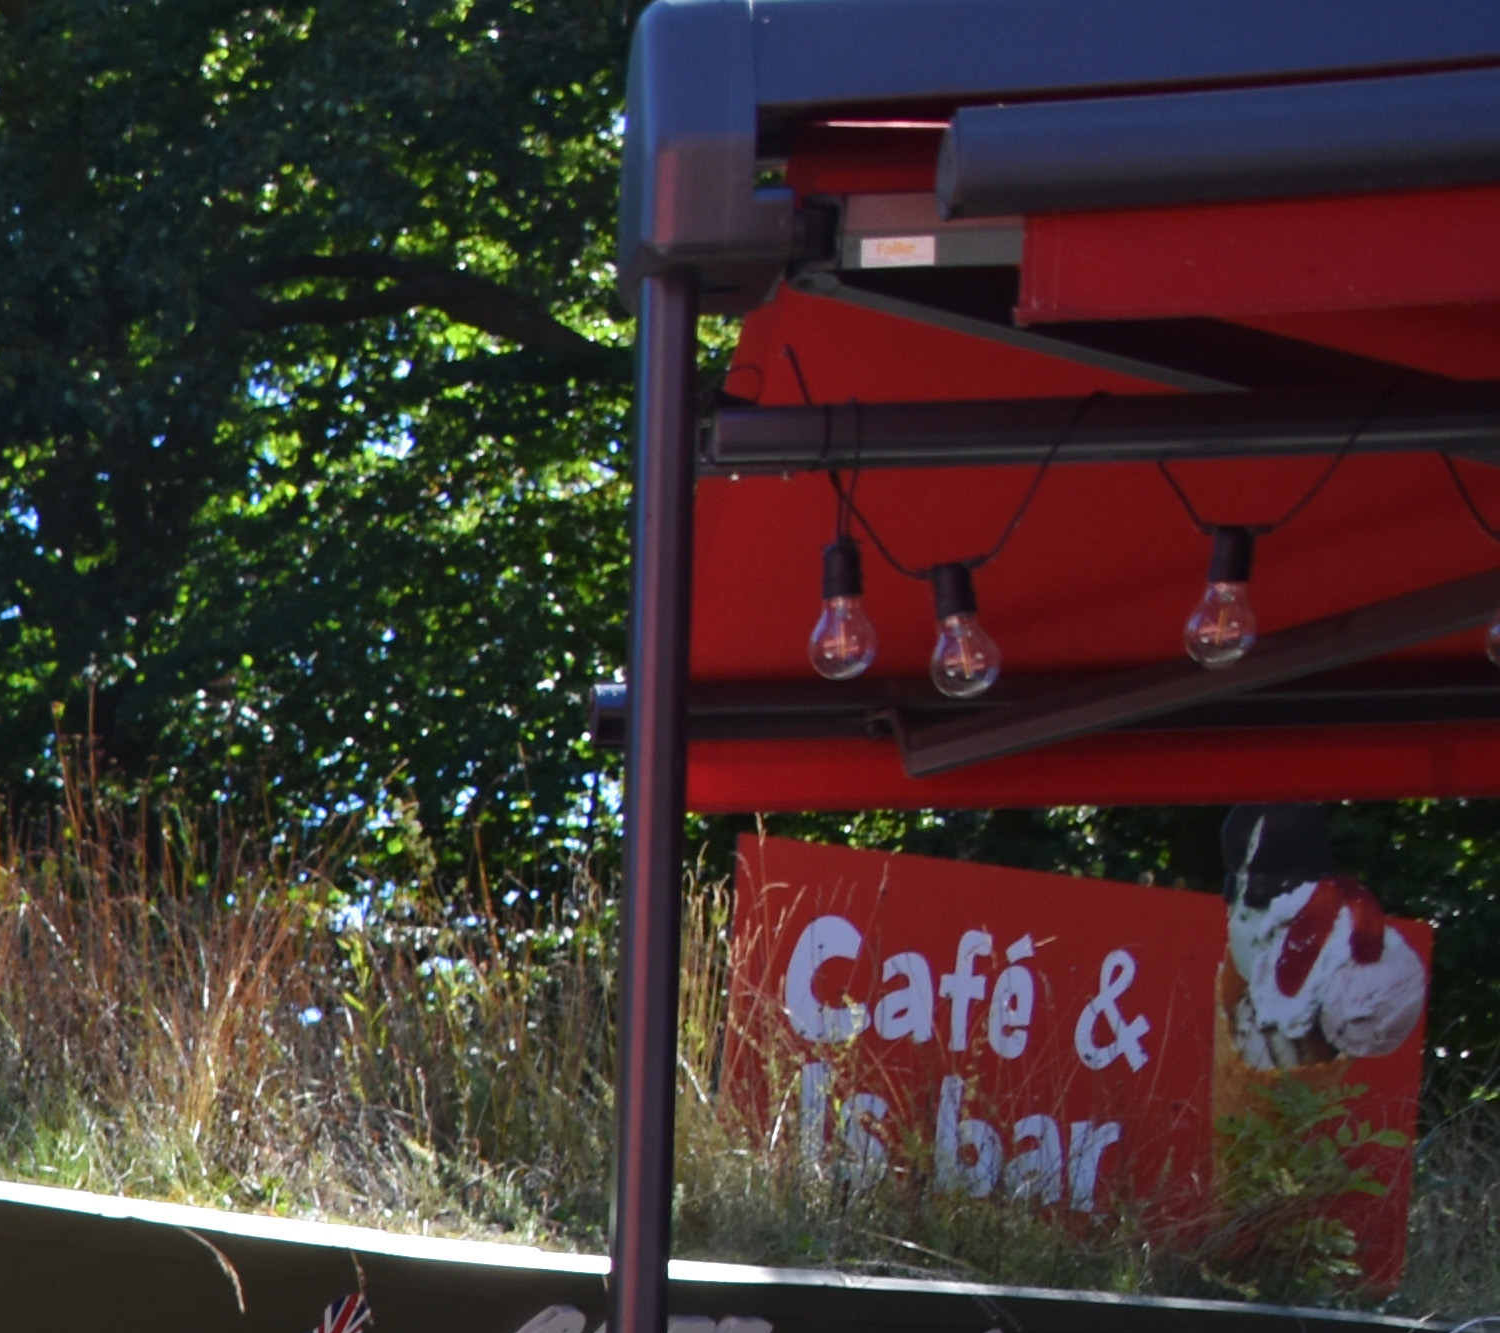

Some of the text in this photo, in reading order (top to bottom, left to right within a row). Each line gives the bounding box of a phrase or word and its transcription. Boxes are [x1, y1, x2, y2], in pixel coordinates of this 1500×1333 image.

[784, 914, 1151, 1074] Café &
[935, 1074, 1122, 1213] bar
